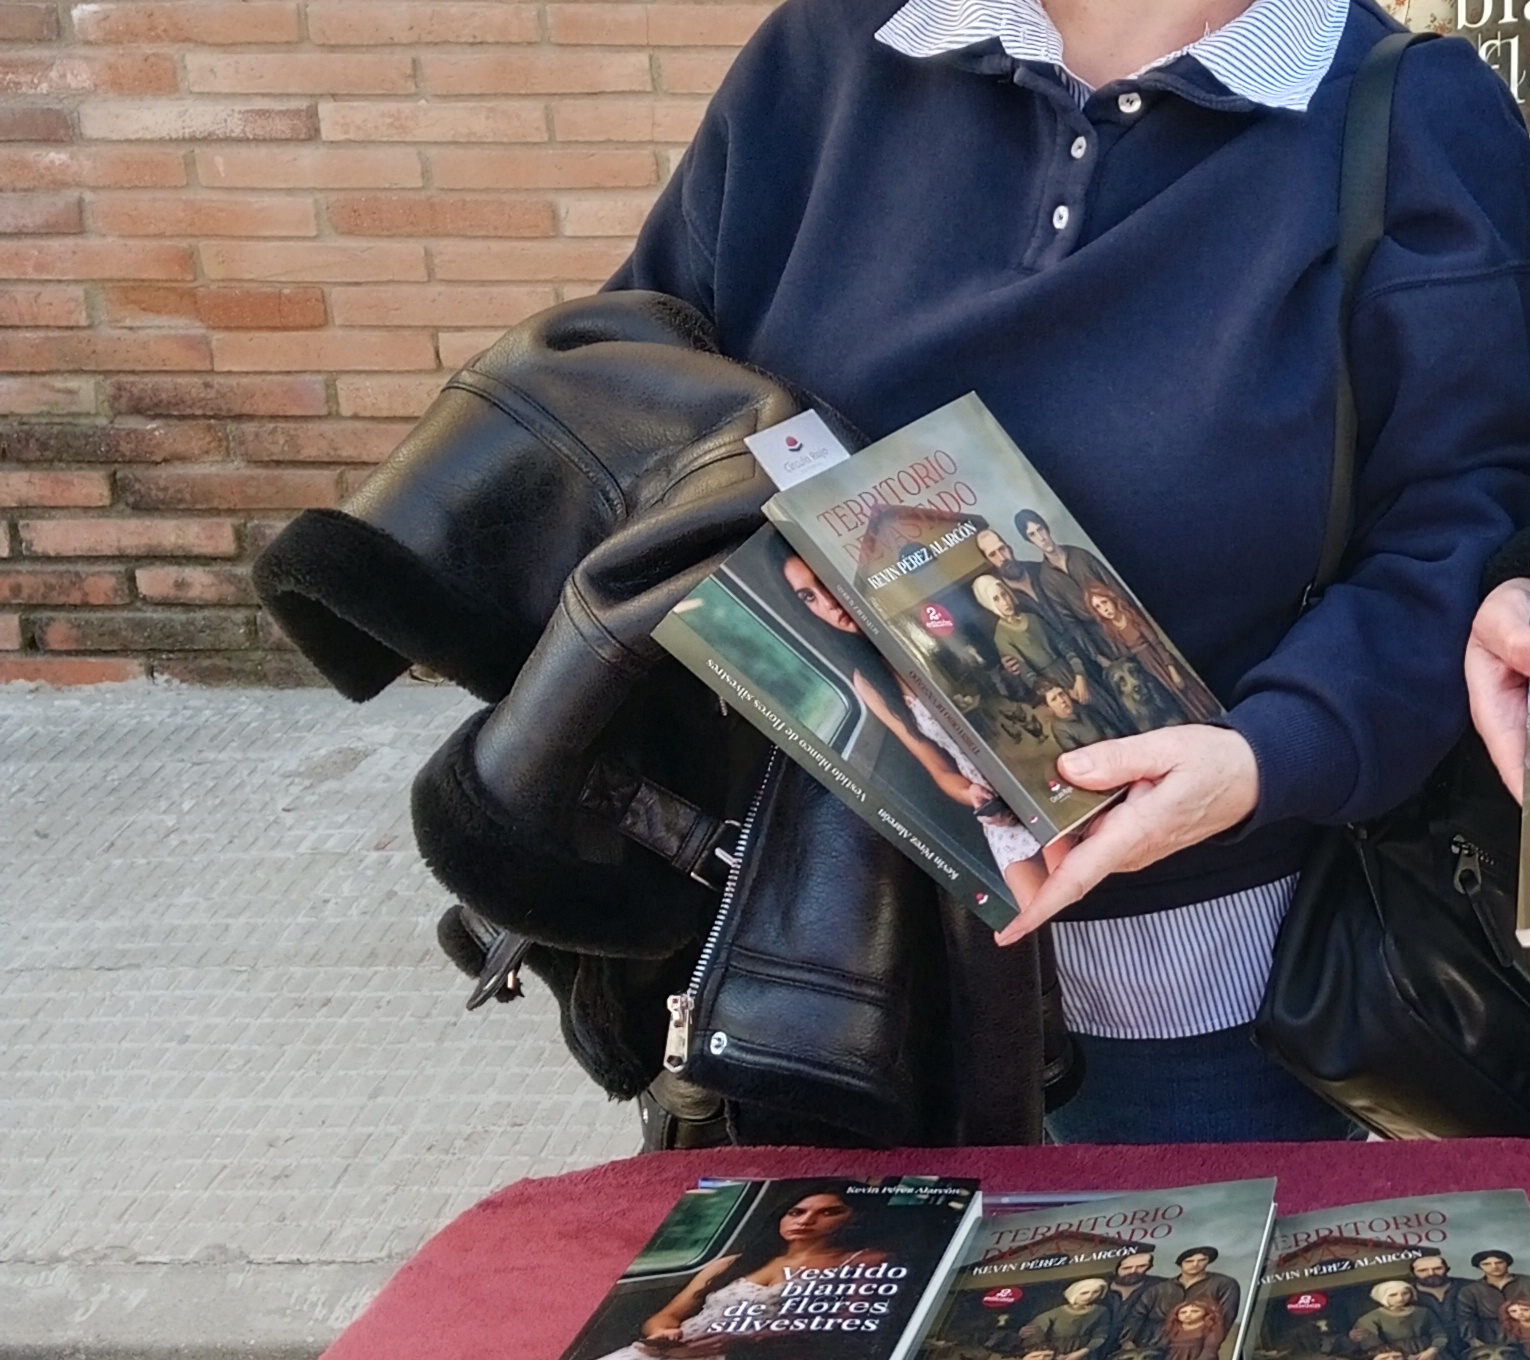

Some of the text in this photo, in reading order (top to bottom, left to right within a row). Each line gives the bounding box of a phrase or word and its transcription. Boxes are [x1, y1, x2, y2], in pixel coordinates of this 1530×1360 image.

[816, 449, 957, 538] TERRITORIO
[867, 520, 978, 590] KEVIN PÉREZ ALARCÓN
[707, 658, 752, 699] silvestres
[753, 697, 785, 730] flores
[785, 724, 799, 740] de
[799, 738, 830, 771] blanco
[831, 767, 867, 802] Vestido
[931, 855, 960, 881] Kevin
[991, 1204, 1184, 1245] TERRITORIO
[781, 1261, 907, 1281] Vestido
[973, 1261, 1016, 1276] KEVIN
[780, 1279, 898, 1298] blanco
[722, 1296, 890, 1317] de flores
[707, 1315, 880, 1334] silvestres
